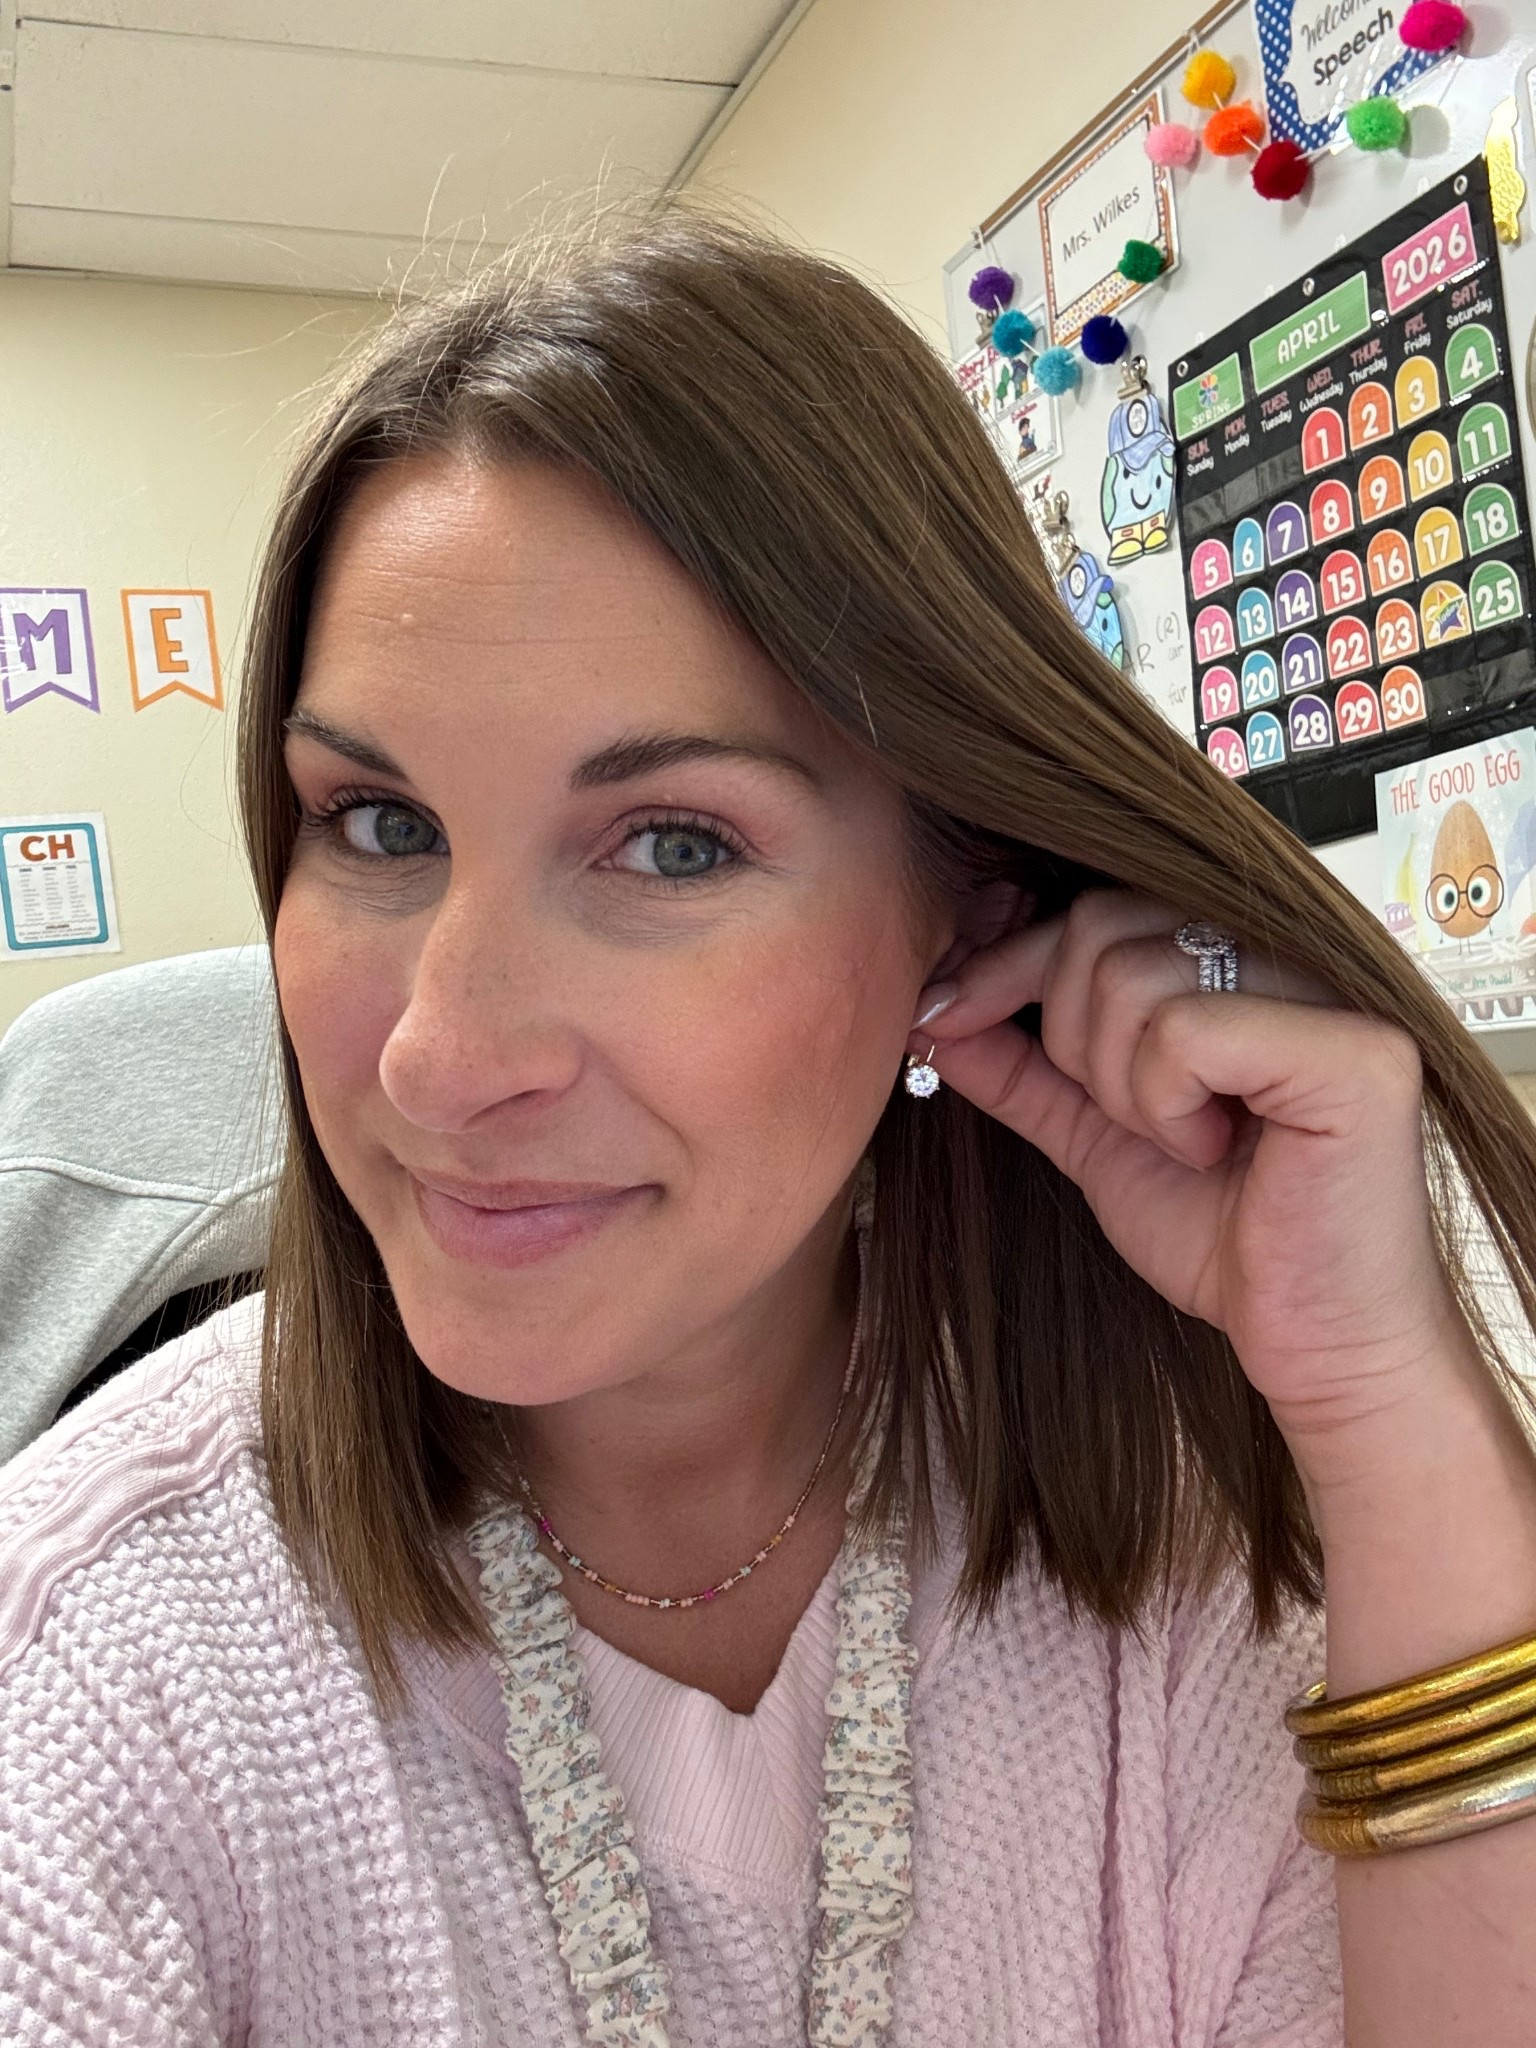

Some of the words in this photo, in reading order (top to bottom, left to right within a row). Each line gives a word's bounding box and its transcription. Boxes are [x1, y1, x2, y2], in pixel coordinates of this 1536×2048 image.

[1063, 231, 1091, 262] Mrs.
[1093, 186, 1140, 234] Wilkes
[1392, 223, 1467, 297] 2026
[1452, 279, 1483, 309] SAT.
[1278, 309, 1340, 364] APRIL
[1186, 456, 1214, 477] Sunday
[1224, 433, 1250, 456] Monday
[1260, 409, 1292, 433] Tuesday
[1299, 381, 1344, 413] Wednesday
[1348, 357, 1388, 385] Thursday
[1404, 332, 1431, 355] Friday
[1446, 298, 1492, 330] Saturday
[1192, 398, 1231, 429] SPRING
[1316, 427, 1329, 460] 1
[1362, 403, 1379, 439] 2
[1408, 378, 1425, 413] 3
[1460, 346, 1483, 379] 4
[1203, 556, 1219, 588] 5
[1242, 537, 1255, 568] 6
[1277, 520, 1292, 554] 7
[1322, 499, 1340, 533] 8
[1370, 476, 1388, 511] 9
[1413, 448, 1444, 490] 10
[1463, 421, 1498, 465] 11
[1200, 620, 1227, 656] 12
[1241, 603, 1267, 638] 13
[1279, 587, 1310, 623] 14
[1327, 566, 1356, 605] 15
[1372, 547, 1405, 586] 16
[1422, 525, 1450, 566] 17
[1471, 502, 1508, 544] 18
[1206, 682, 1232, 716] 19
[1245, 666, 1274, 704] 20
[1289, 649, 1316, 687] 21
[1331, 631, 1366, 672] 22
[1380, 616, 1413, 656] 23
[1475, 577, 1515, 622] 25
[1212, 742, 1243, 774] 26
[1251, 727, 1277, 761] 27
[1293, 710, 1327, 745] 28
[1341, 697, 1372, 735] 29
[1385, 682, 1419, 721] 30
[1390, 778, 1420, 816] THE
[1429, 762, 1475, 803] GOOD
[1484, 749, 1520, 788] EGG
[20, 834, 75, 862] CH
